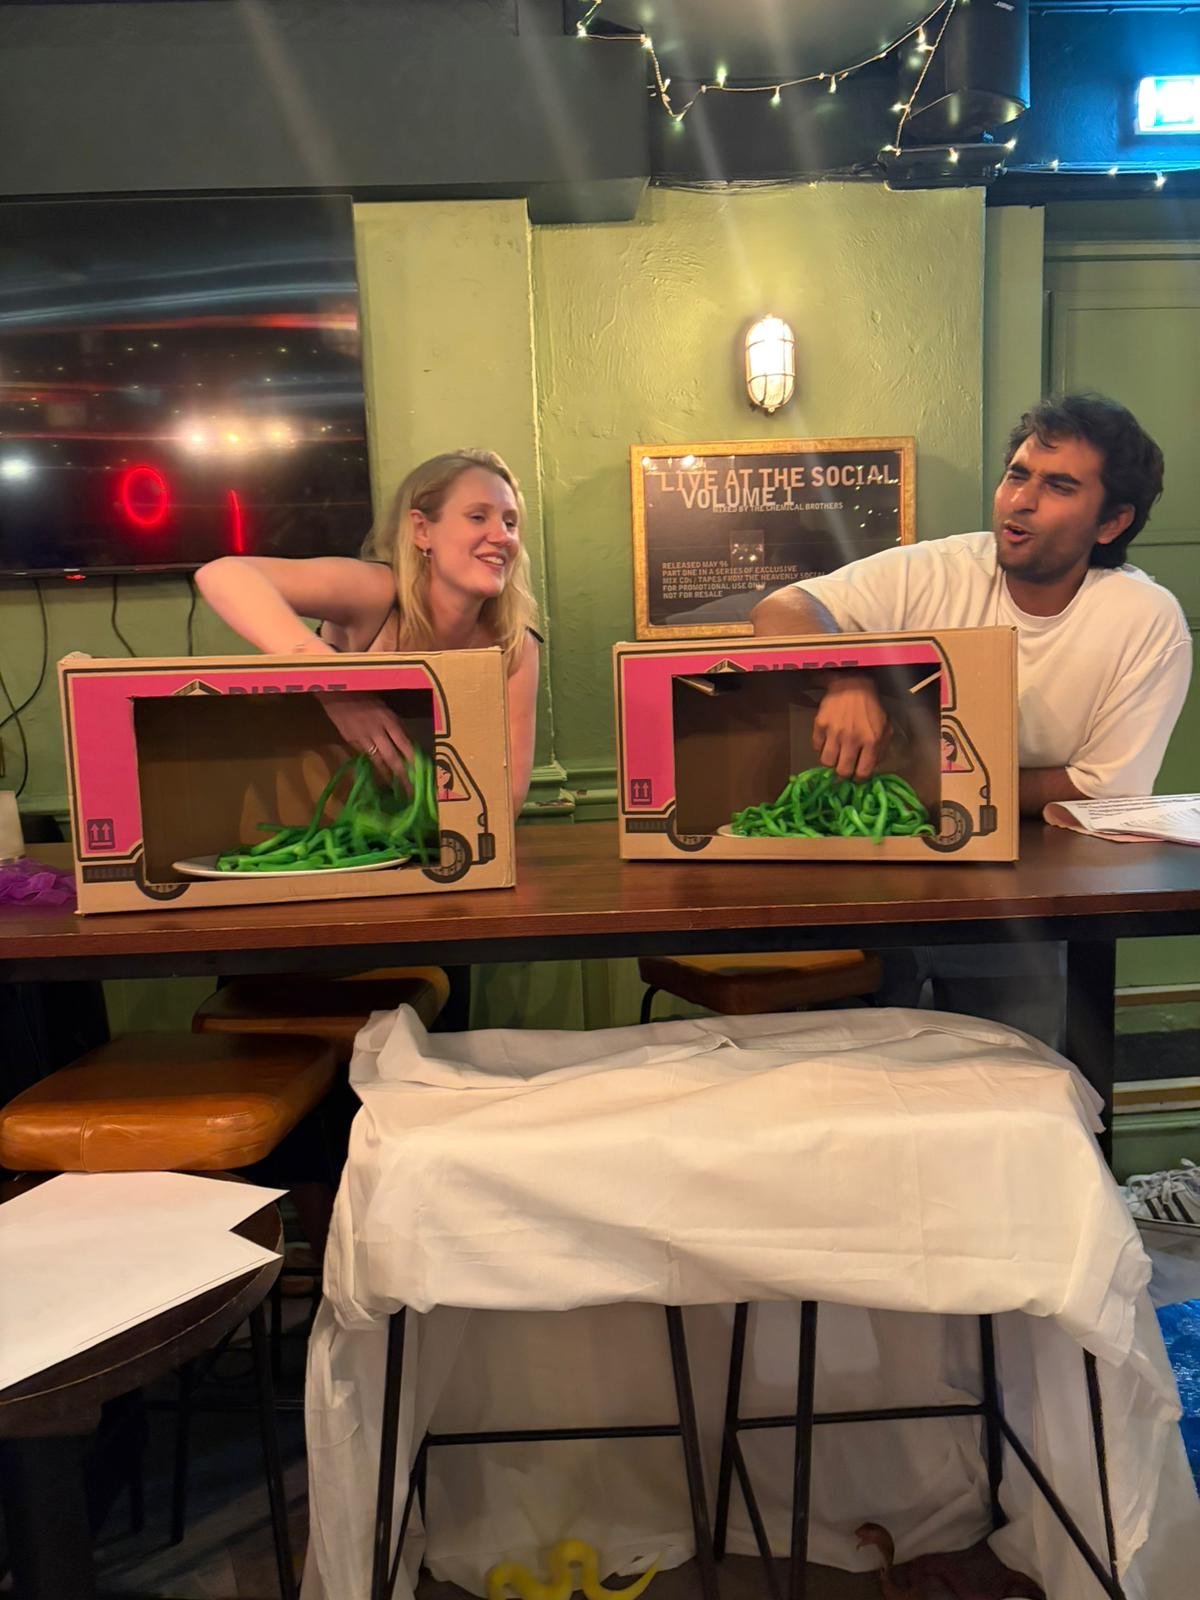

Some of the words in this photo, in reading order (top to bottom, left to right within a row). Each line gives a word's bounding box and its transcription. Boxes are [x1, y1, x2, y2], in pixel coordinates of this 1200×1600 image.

[662, 471, 718, 491] LIVE
[725, 469, 753, 489] AT
[759, 467, 805, 488] THE
[811, 465, 896, 486] SOCIAL
[681, 486, 776, 509] VOLUME
[783, 486, 795, 506] 1
[805, 501, 844, 510] BROTHERS
[662, 561, 701, 569] RELEASED
[662, 569, 681, 577] PART
[681, 568, 698, 577] ONE
[698, 568, 708, 576] IN
[755, 566, 797, 574] EXCLUSIVE
[662, 576, 677, 585] MIX
[698, 575, 723, 583] TAPES
[745, 574, 760, 582] THE
[761, 573, 799, 581] HEAVENLY
[662, 584, 677, 592] FOR
[678, 583, 731, 591] PROMOTIONAL
[732, 582, 746, 590] USE
[679, 591, 693, 599] FOR
